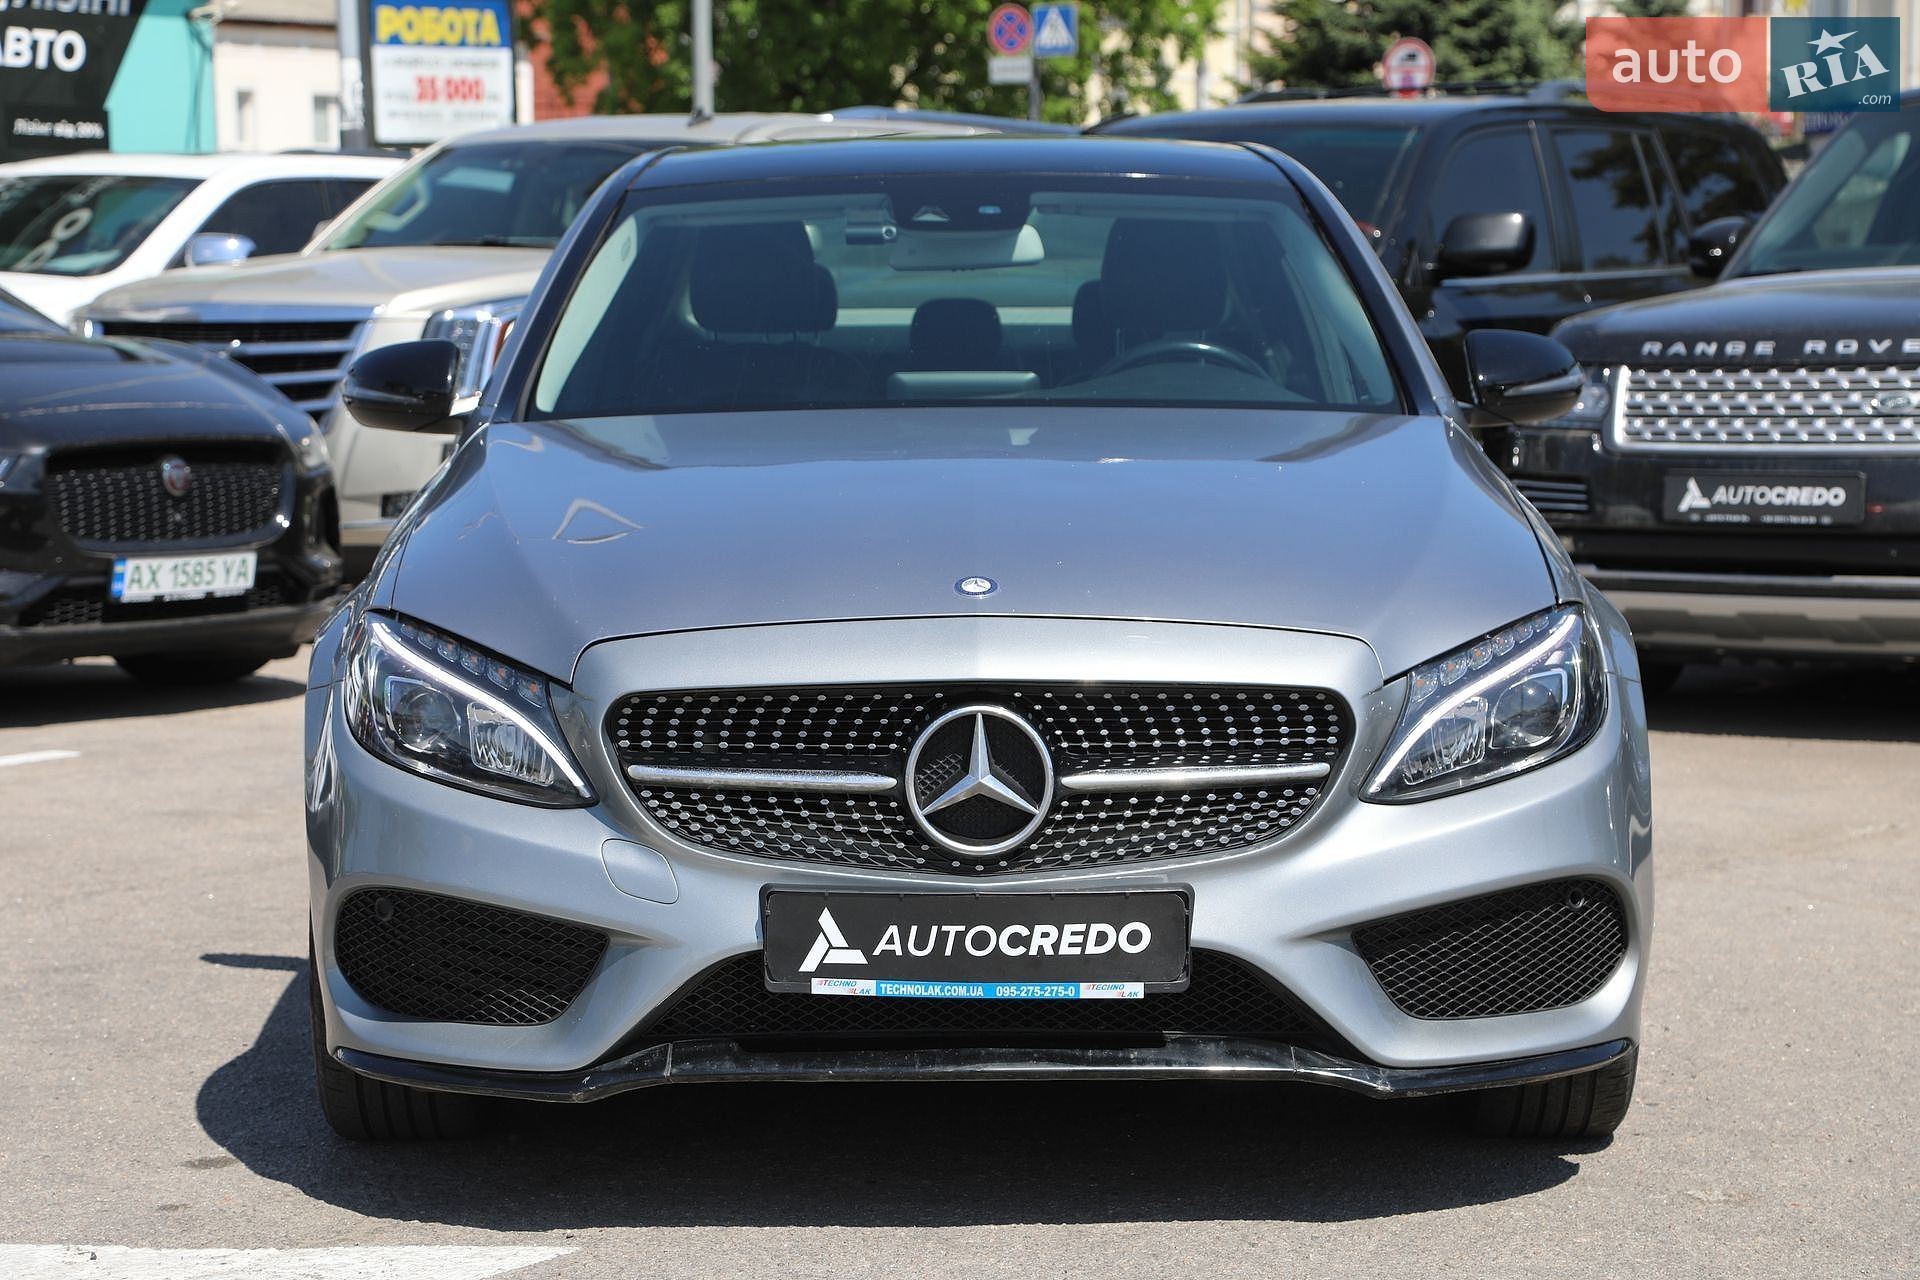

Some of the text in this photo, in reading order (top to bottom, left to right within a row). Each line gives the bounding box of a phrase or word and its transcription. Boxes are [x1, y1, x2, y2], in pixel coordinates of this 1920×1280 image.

[376, 5, 501, 46] РОБОТА
[0, 26, 87, 72] ВТО
[1641, 340, 1776, 356] RANGE
[1711, 485, 1847, 507] AUTOCREDO
[127, 562, 163, 590] AX
[872, 921, 1152, 957] AUTOCREDO
[879, 983, 1075, 997] TECHNOLAK.COM.UA 095-275-275-0
